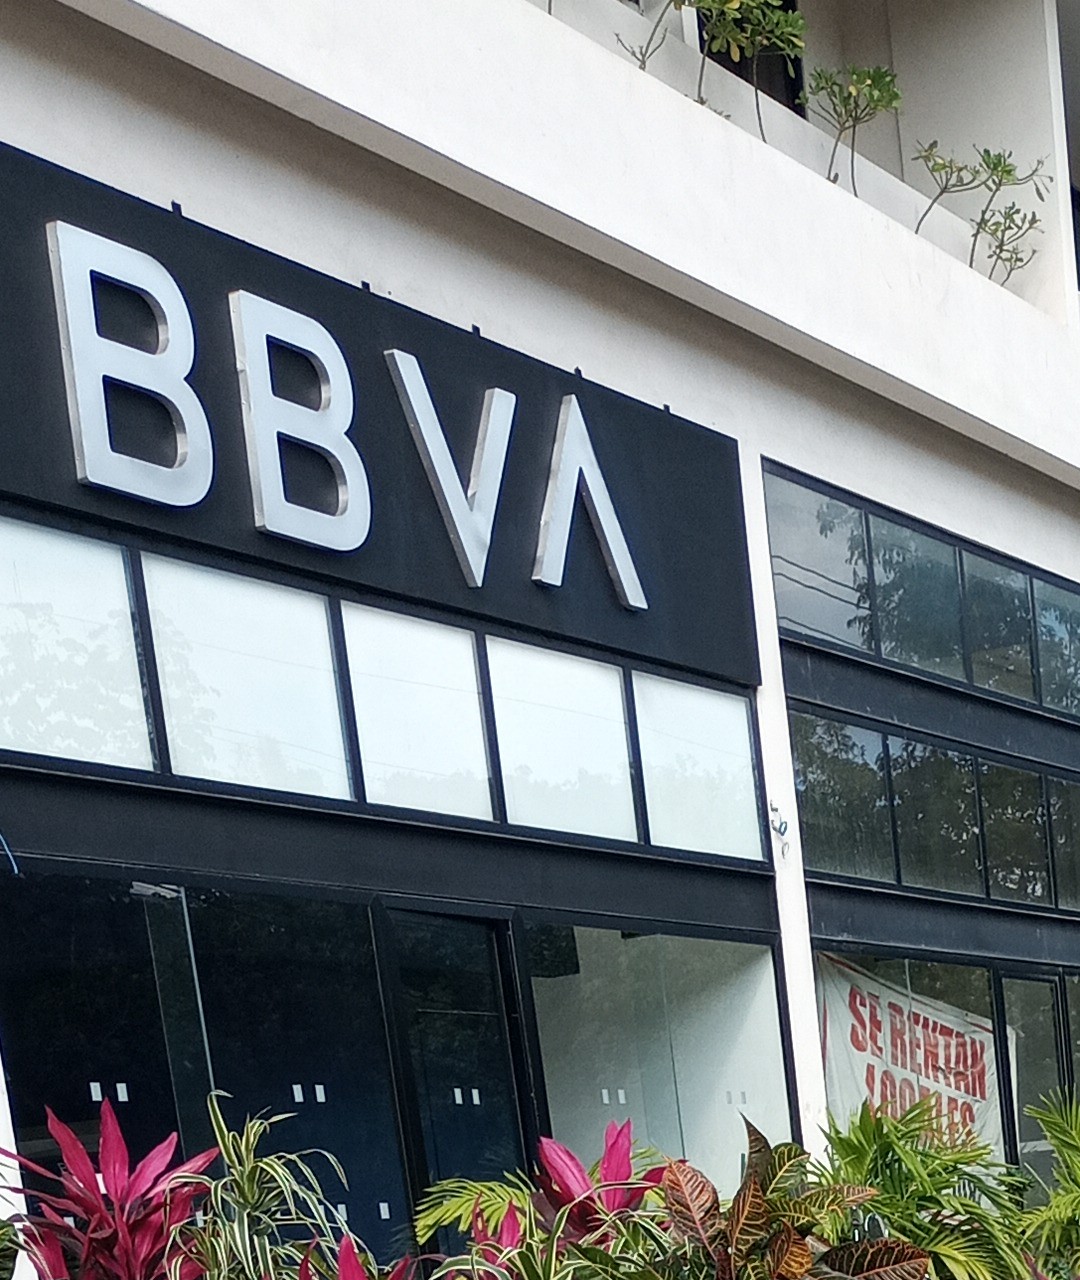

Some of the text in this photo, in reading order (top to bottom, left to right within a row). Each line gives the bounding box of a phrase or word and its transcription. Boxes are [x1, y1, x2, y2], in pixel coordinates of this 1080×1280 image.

[45, 218, 648, 611] BBVA
[849, 985, 987, 1101] SE RENTAN
